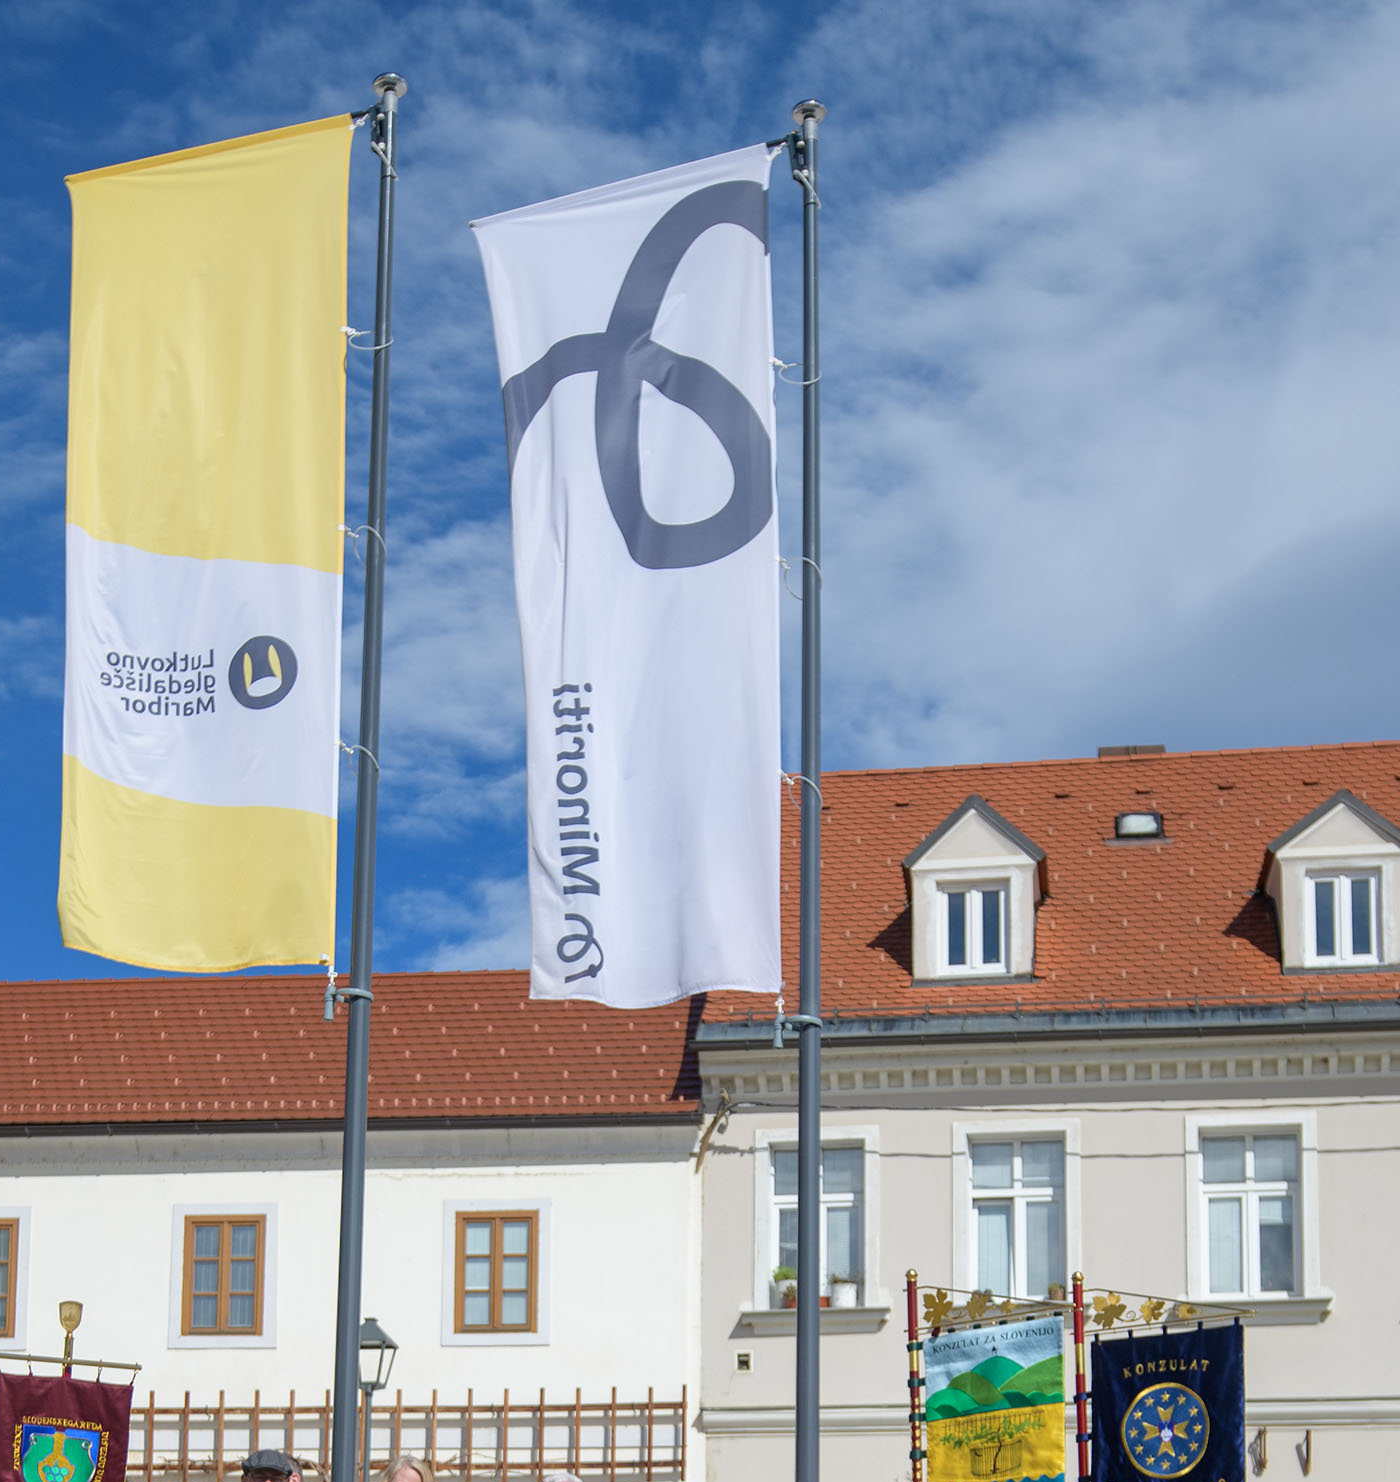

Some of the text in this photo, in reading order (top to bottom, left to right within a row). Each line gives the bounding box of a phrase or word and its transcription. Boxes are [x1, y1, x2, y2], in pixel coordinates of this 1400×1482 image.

[932, 1326, 1054, 1355] KONZULAT ZA SLOVENIJO
[1123, 1359, 1210, 1379] KONZULAT
